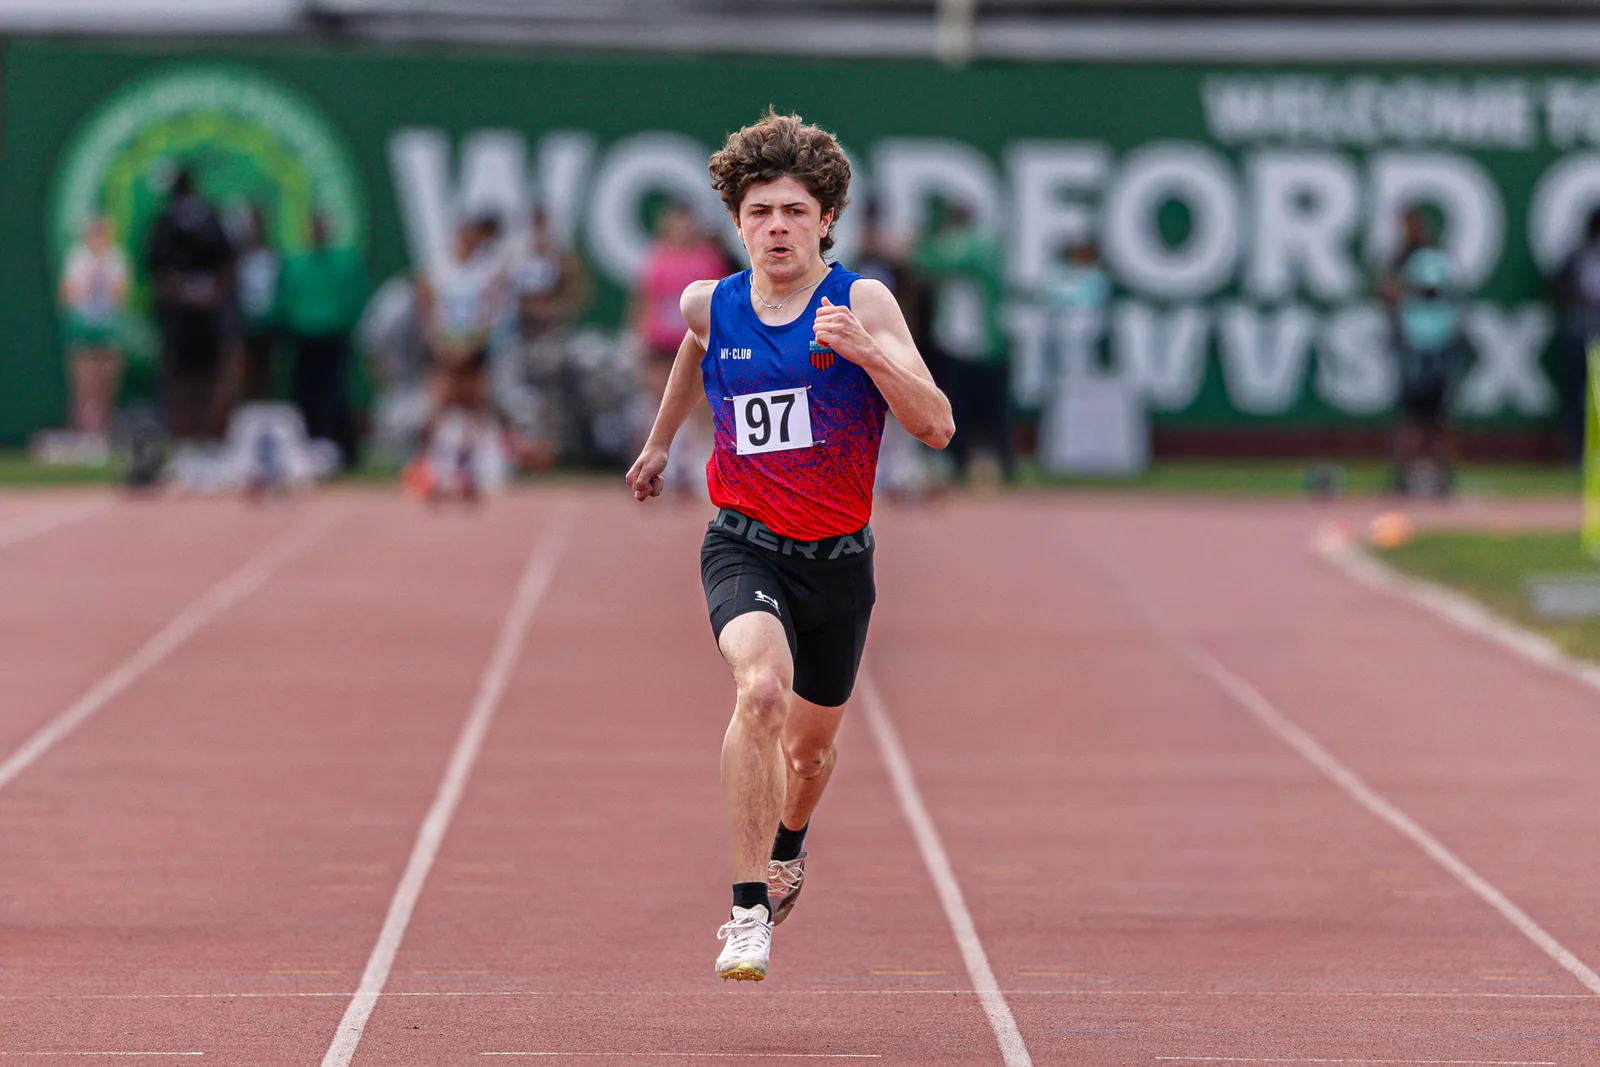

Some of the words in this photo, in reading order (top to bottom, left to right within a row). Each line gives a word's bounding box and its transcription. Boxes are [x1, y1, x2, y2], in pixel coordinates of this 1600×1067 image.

[388, 128, 1506, 299] WODFORD
[744, 393, 796, 447] 97
[713, 508, 817, 560] DER
